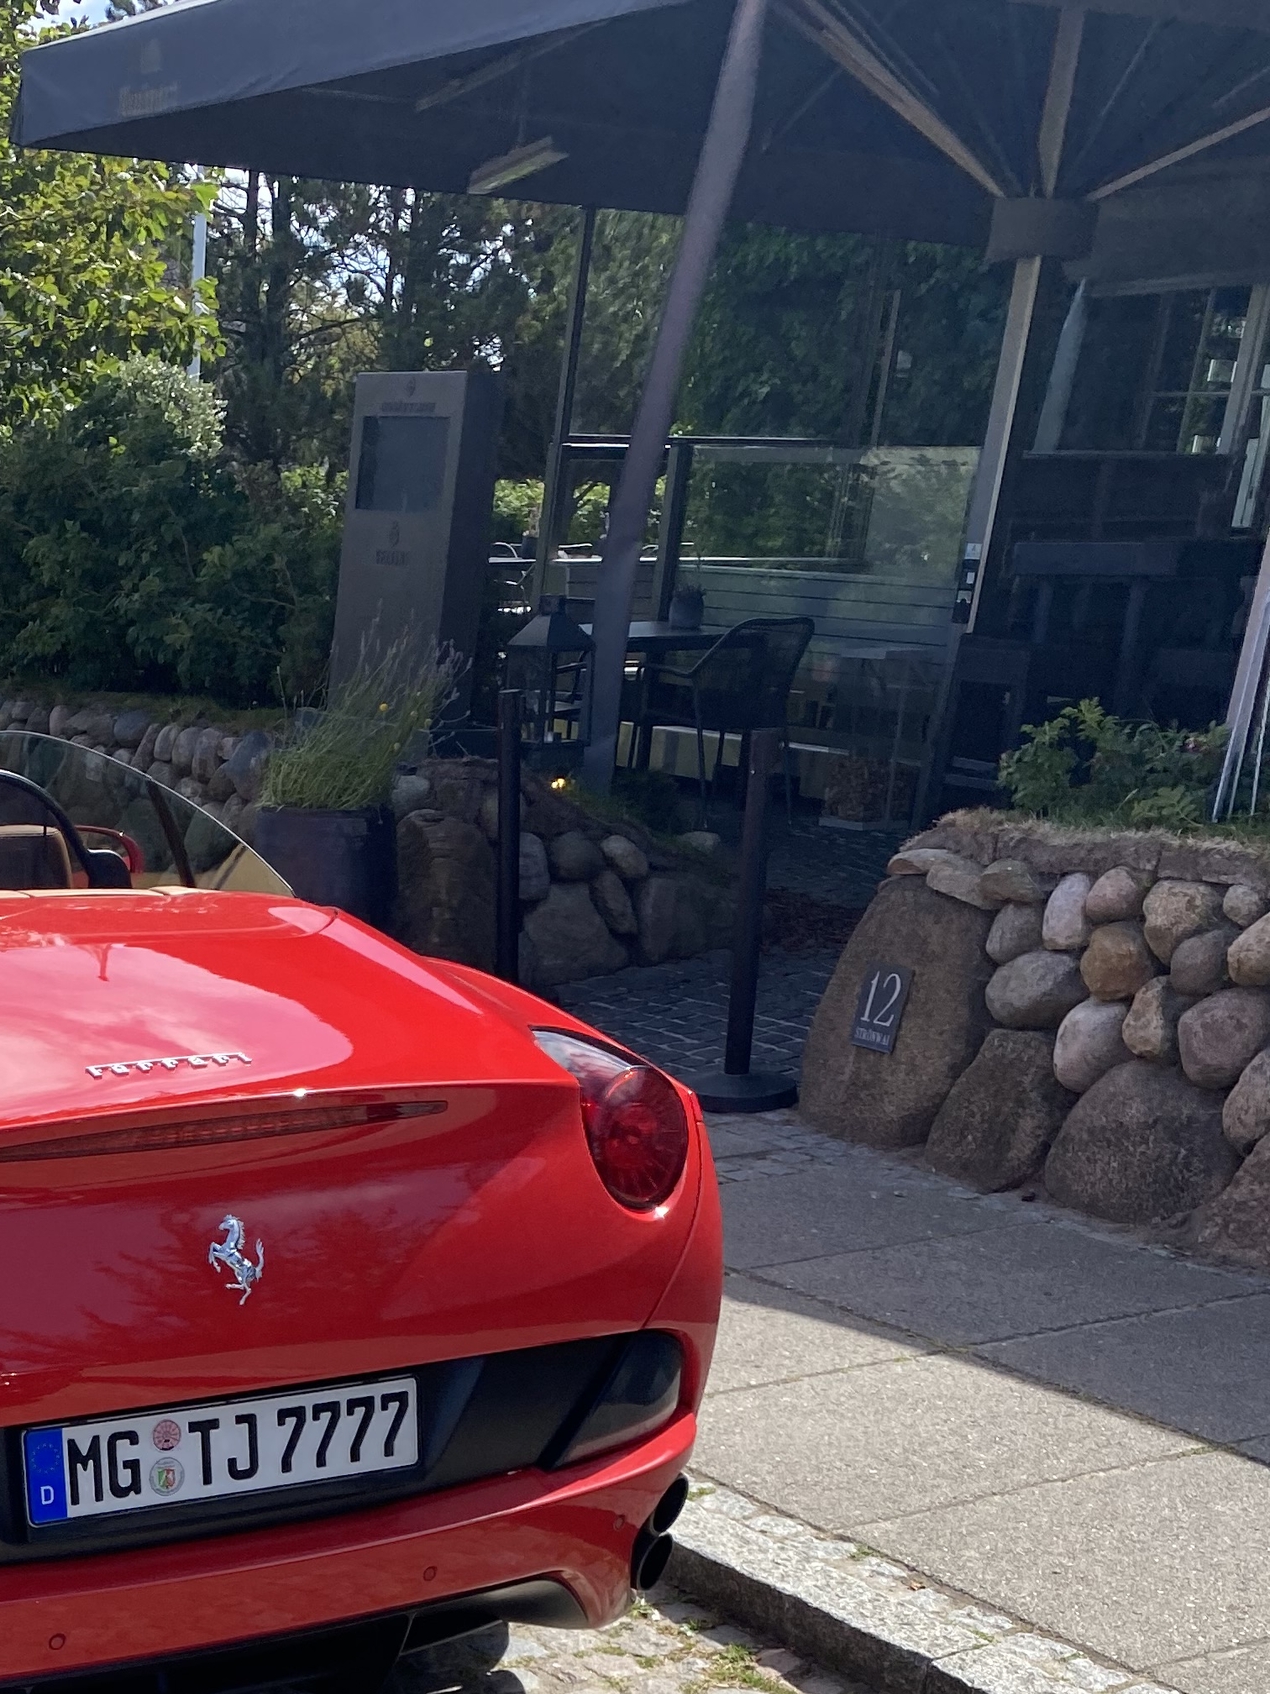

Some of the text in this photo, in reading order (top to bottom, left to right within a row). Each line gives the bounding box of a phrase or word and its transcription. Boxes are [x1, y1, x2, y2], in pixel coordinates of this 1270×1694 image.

[860, 970, 902, 1027] 12
[85, 1051, 253, 1080] Ferrari
[40, 1389, 410, 1507] D MG TJ 7777
